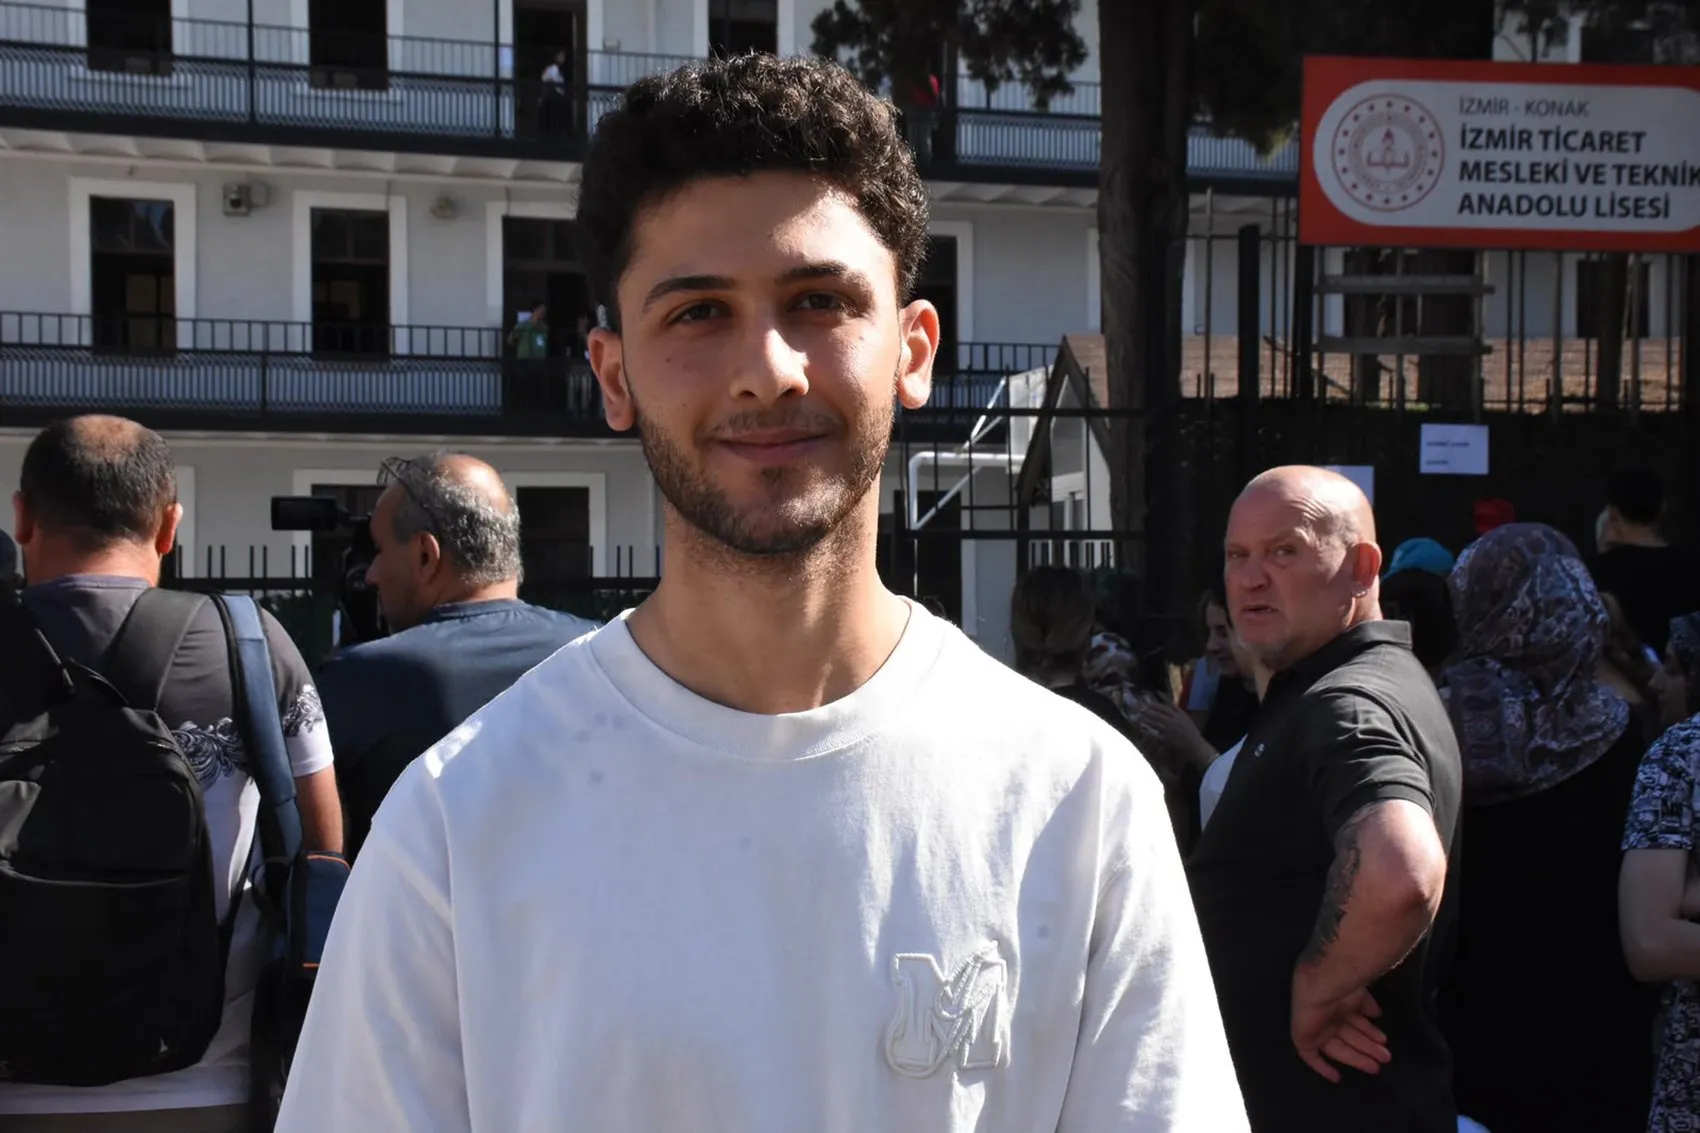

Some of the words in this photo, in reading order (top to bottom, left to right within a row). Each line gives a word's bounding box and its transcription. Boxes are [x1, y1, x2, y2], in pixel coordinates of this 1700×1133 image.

[1460, 94, 1509, 116] İZMİR
[1525, 98, 1589, 117] KONAK
[1461, 123, 1533, 151] İZMİR
[1539, 125, 1646, 154] TİCARET
[1460, 157, 1568, 184] MESLEKİ
[1574, 163, 1607, 185] VE
[1611, 160, 1700, 187] TEKNİK
[1458, 192, 1587, 217] ANADOLU
[1595, 191, 1670, 219] LİSESİ
